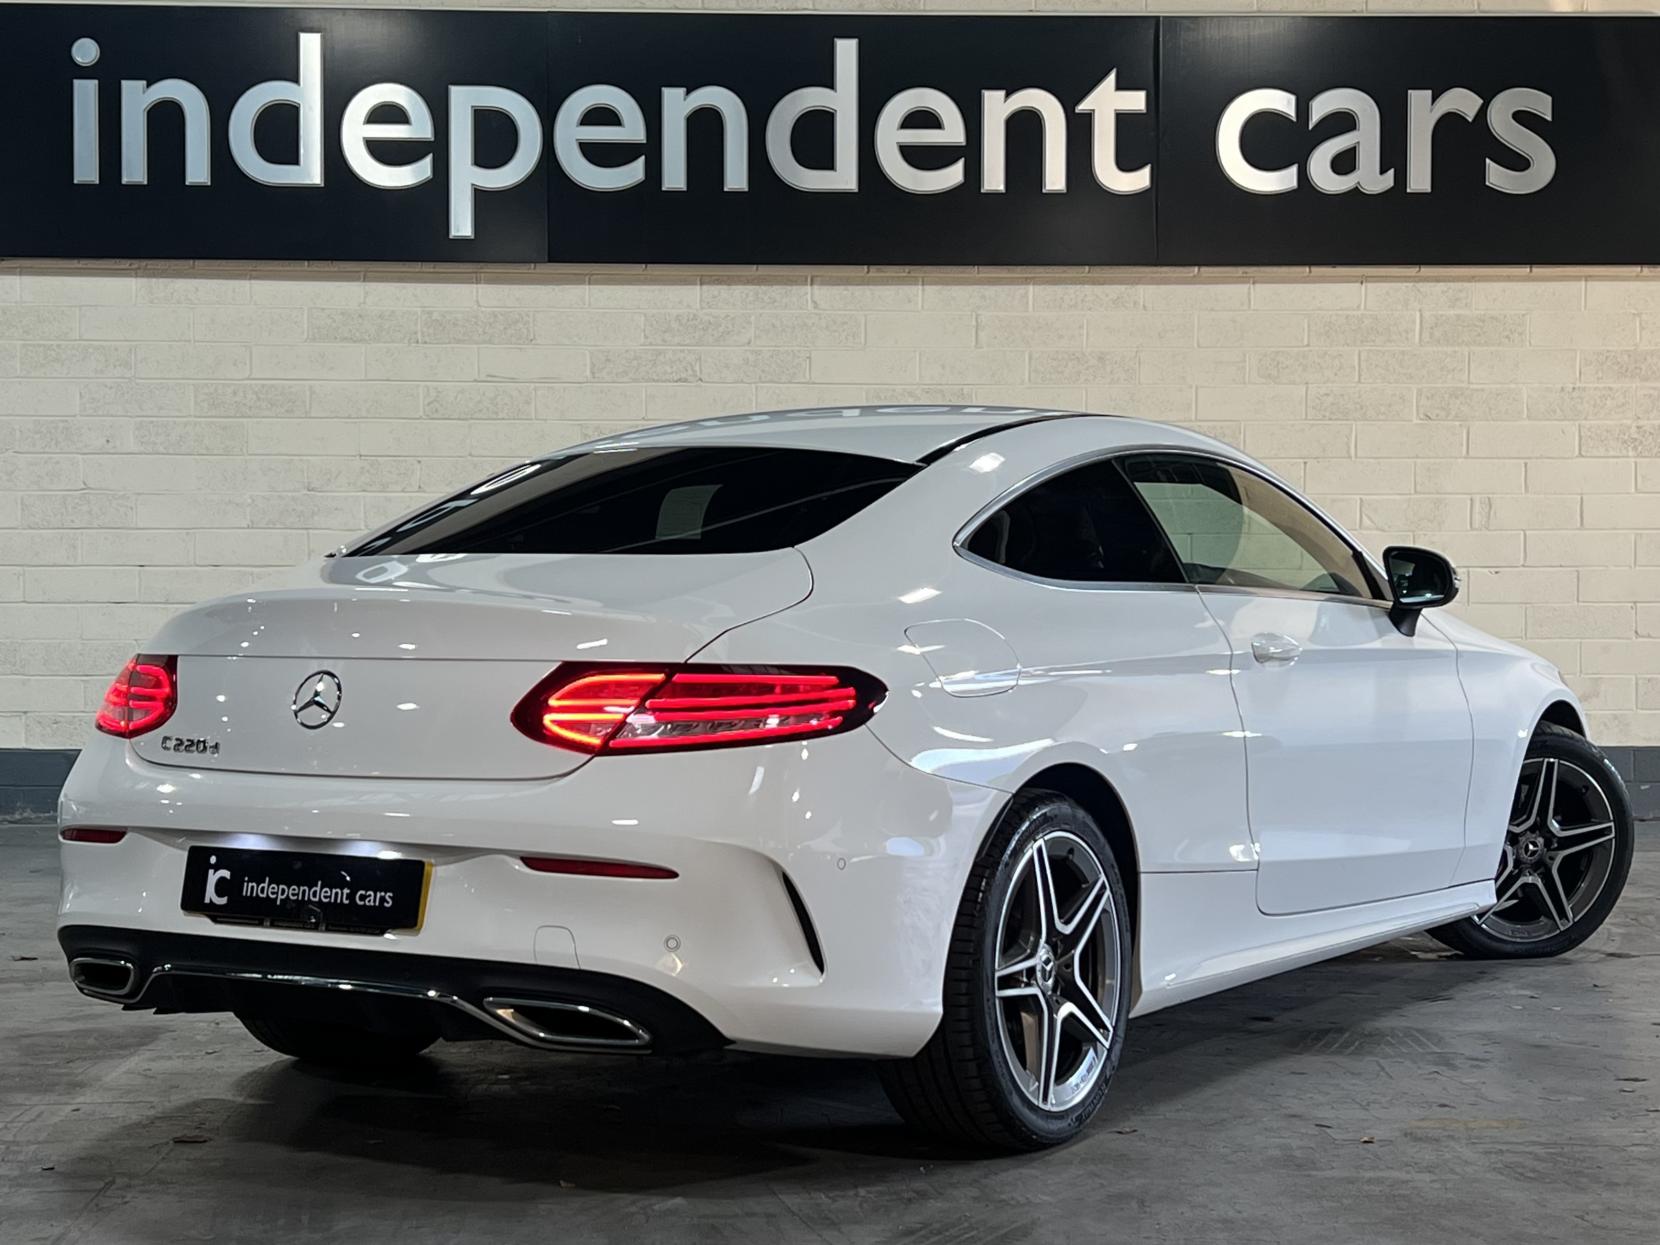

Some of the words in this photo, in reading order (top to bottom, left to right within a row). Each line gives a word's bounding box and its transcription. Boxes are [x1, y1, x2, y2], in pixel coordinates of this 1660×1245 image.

[71, 31, 1152, 240] independent
[1215, 87, 1558, 195] cars
[242, 876, 351, 906] independent
[355, 889, 394, 908] cars
